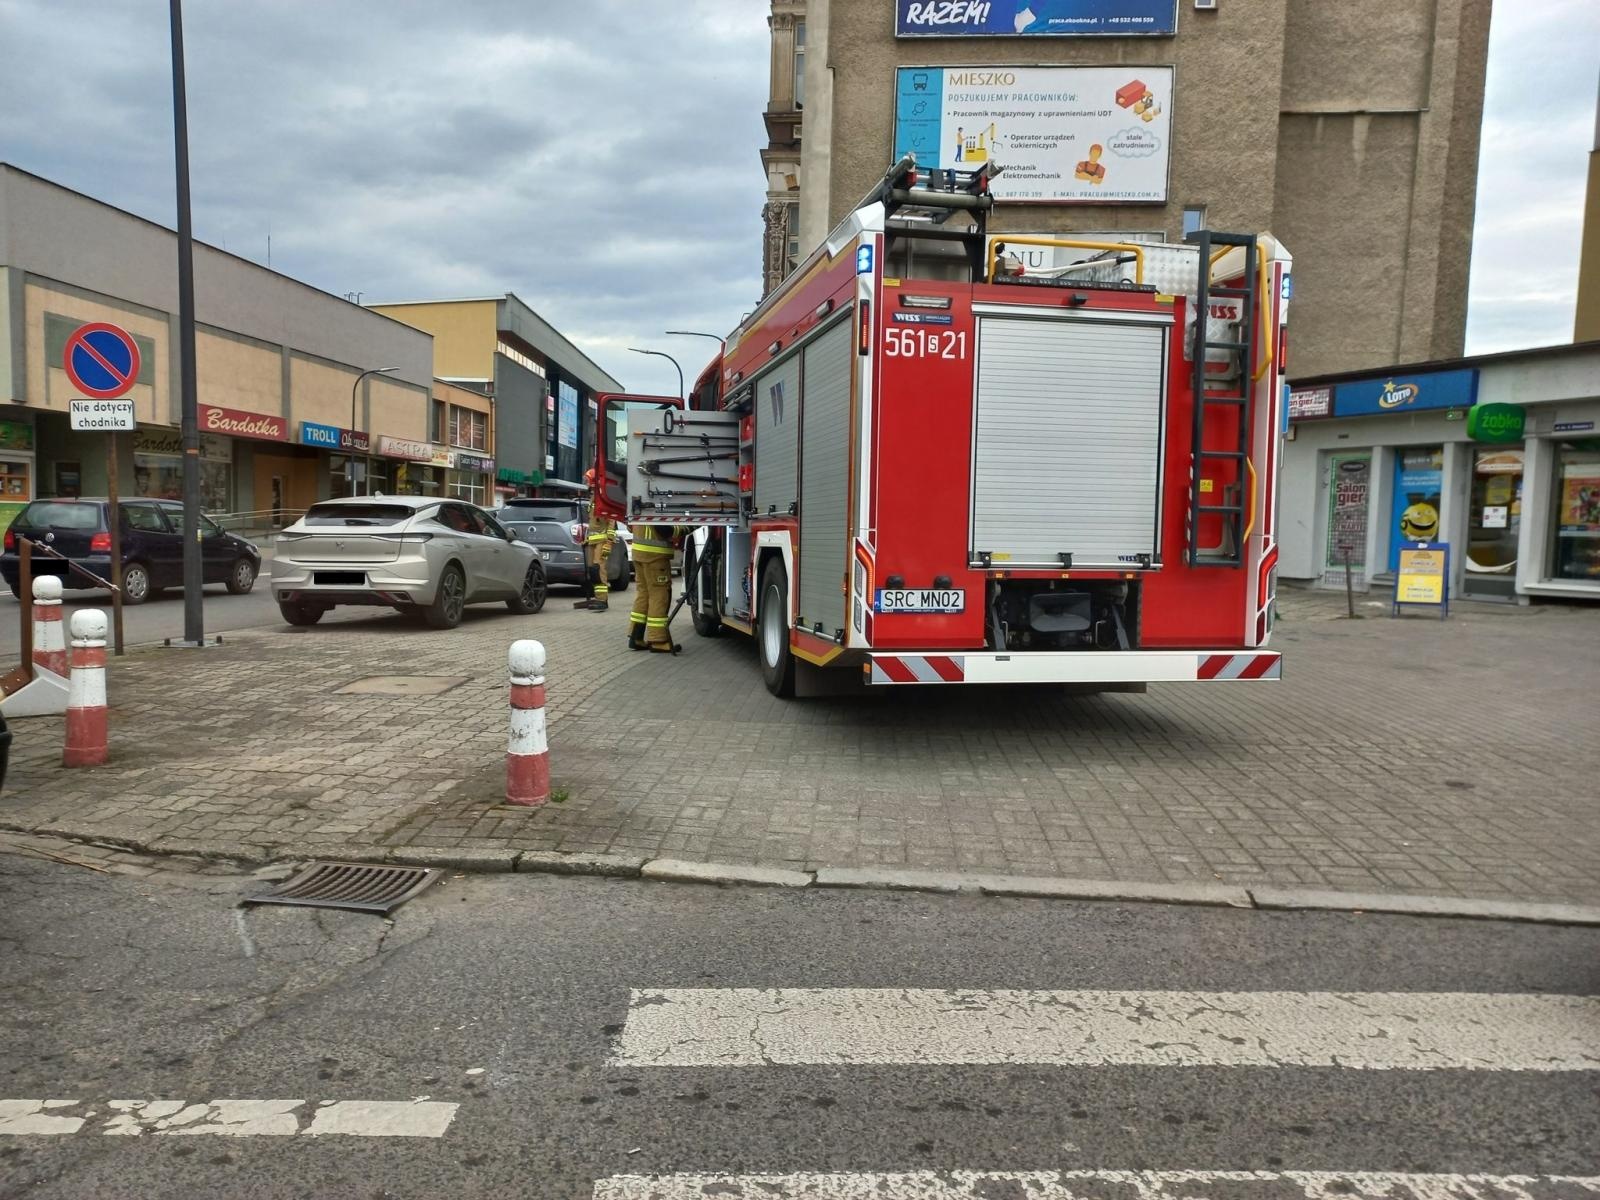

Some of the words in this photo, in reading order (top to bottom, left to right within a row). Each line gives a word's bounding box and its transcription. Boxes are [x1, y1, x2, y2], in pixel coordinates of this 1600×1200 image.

[906, 0, 991, 25] RAZEM!
[949, 72, 1016, 86] MIESZKO
[948, 93, 1009, 102] POSZUKUJEMY
[1012, 92, 1079, 102] PRACOWNIKÓW:
[1043, 110, 1096, 118] uprawnieniami
[1010, 134, 1042, 142] Operator
[1043, 133, 1075, 142] urządzeń
[72, 402, 90, 412] Nie
[93, 402, 133, 414] dotyczy
[78, 417, 126, 427] chodnika
[206, 408, 281, 437] Bardotka
[306, 427, 336, 443] TROLL
[1336, 482, 1366, 493] Salon
[1337, 493, 1363, 506] gier
[884, 591, 915, 608] SRC
[920, 591, 960, 608] MN02
